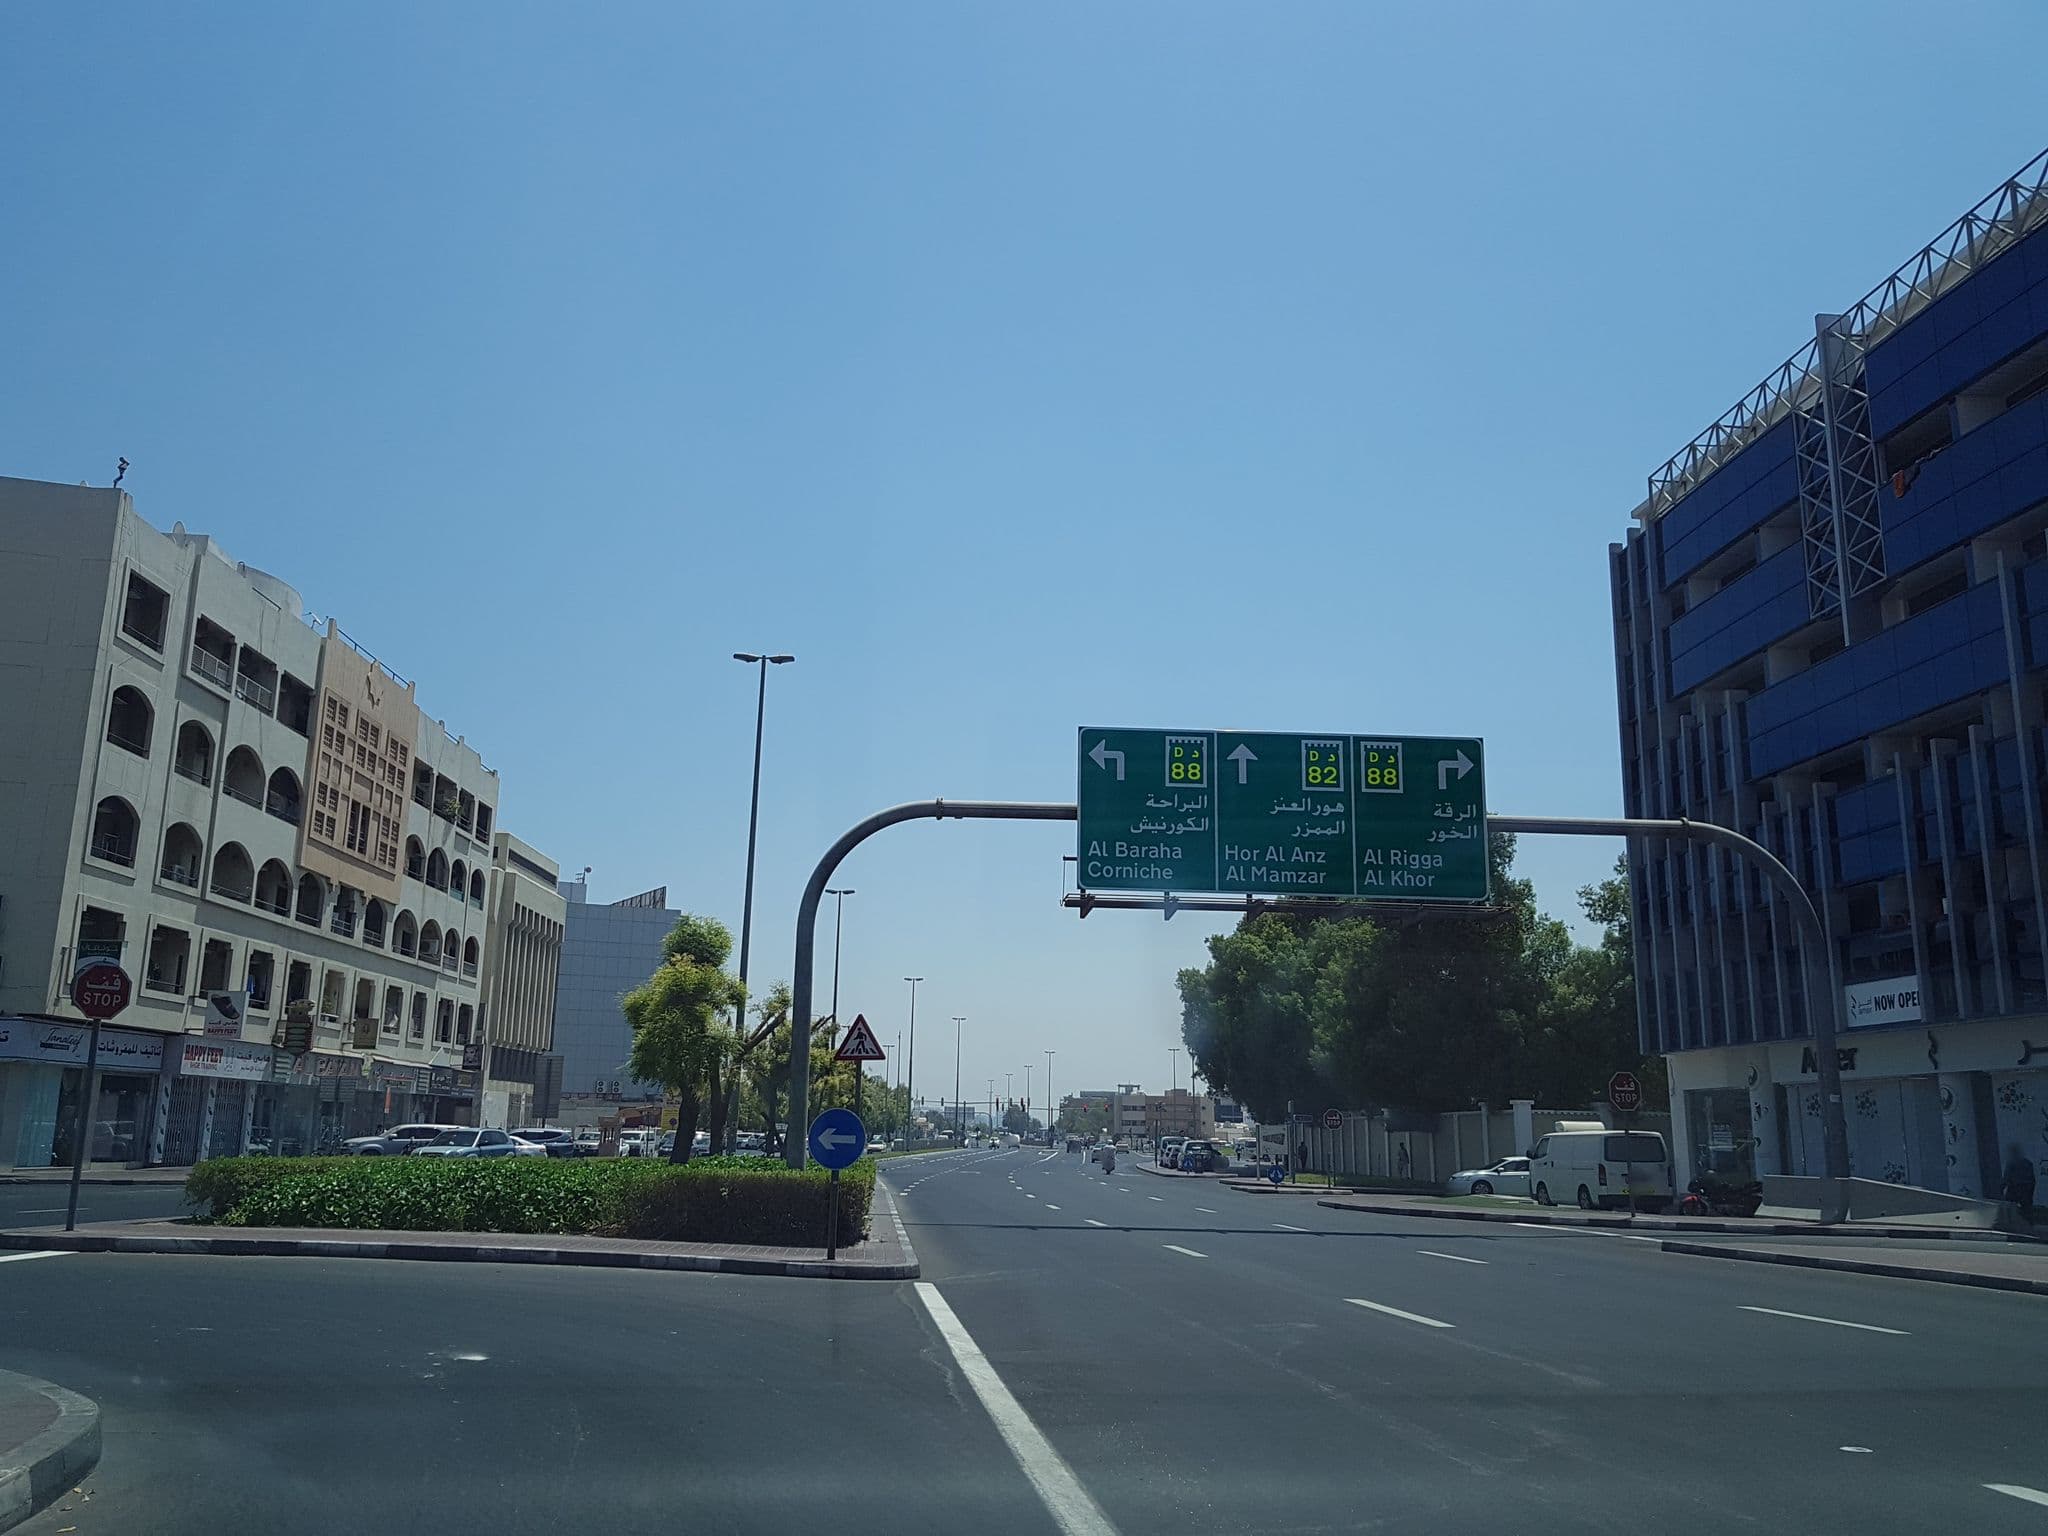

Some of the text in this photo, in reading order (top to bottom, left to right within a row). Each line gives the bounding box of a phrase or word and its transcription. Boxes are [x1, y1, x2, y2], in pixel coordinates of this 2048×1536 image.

[1174, 747, 1183, 758] D
[1309, 750, 1319, 762] D
[1369, 751, 1379, 763] D
[1171, 762, 1201, 780] 88
[1307, 765, 1338, 784] 82
[1367, 767, 1398, 785] 88
[1146, 793, 1208, 812] البراحة
[1433, 802, 1477, 822] الرقة
[1130, 815, 1209, 835] الكورنيش
[1291, 820, 1345, 838] الممزر
[1427, 825, 1478, 843] الخور
[1088, 840, 1182, 859] Al Baraha
[1225, 844, 1327, 863] Hor Al Anz
[1363, 848, 1443, 869] Al Rigga
[1088, 860, 1174, 879] Corniche
[1226, 865, 1327, 884] Al Mamzar
[1363, 869, 1435, 887] Al Khor
[86, 974, 121, 991] قف
[82, 991, 121, 1007] STOP
[1873, 993, 1896, 1011] NOW
[184, 1044, 224, 1063] HAPPY FEET
[1614, 1078, 1636, 1091] قف
[1614, 1093, 1638, 1103] STOP
